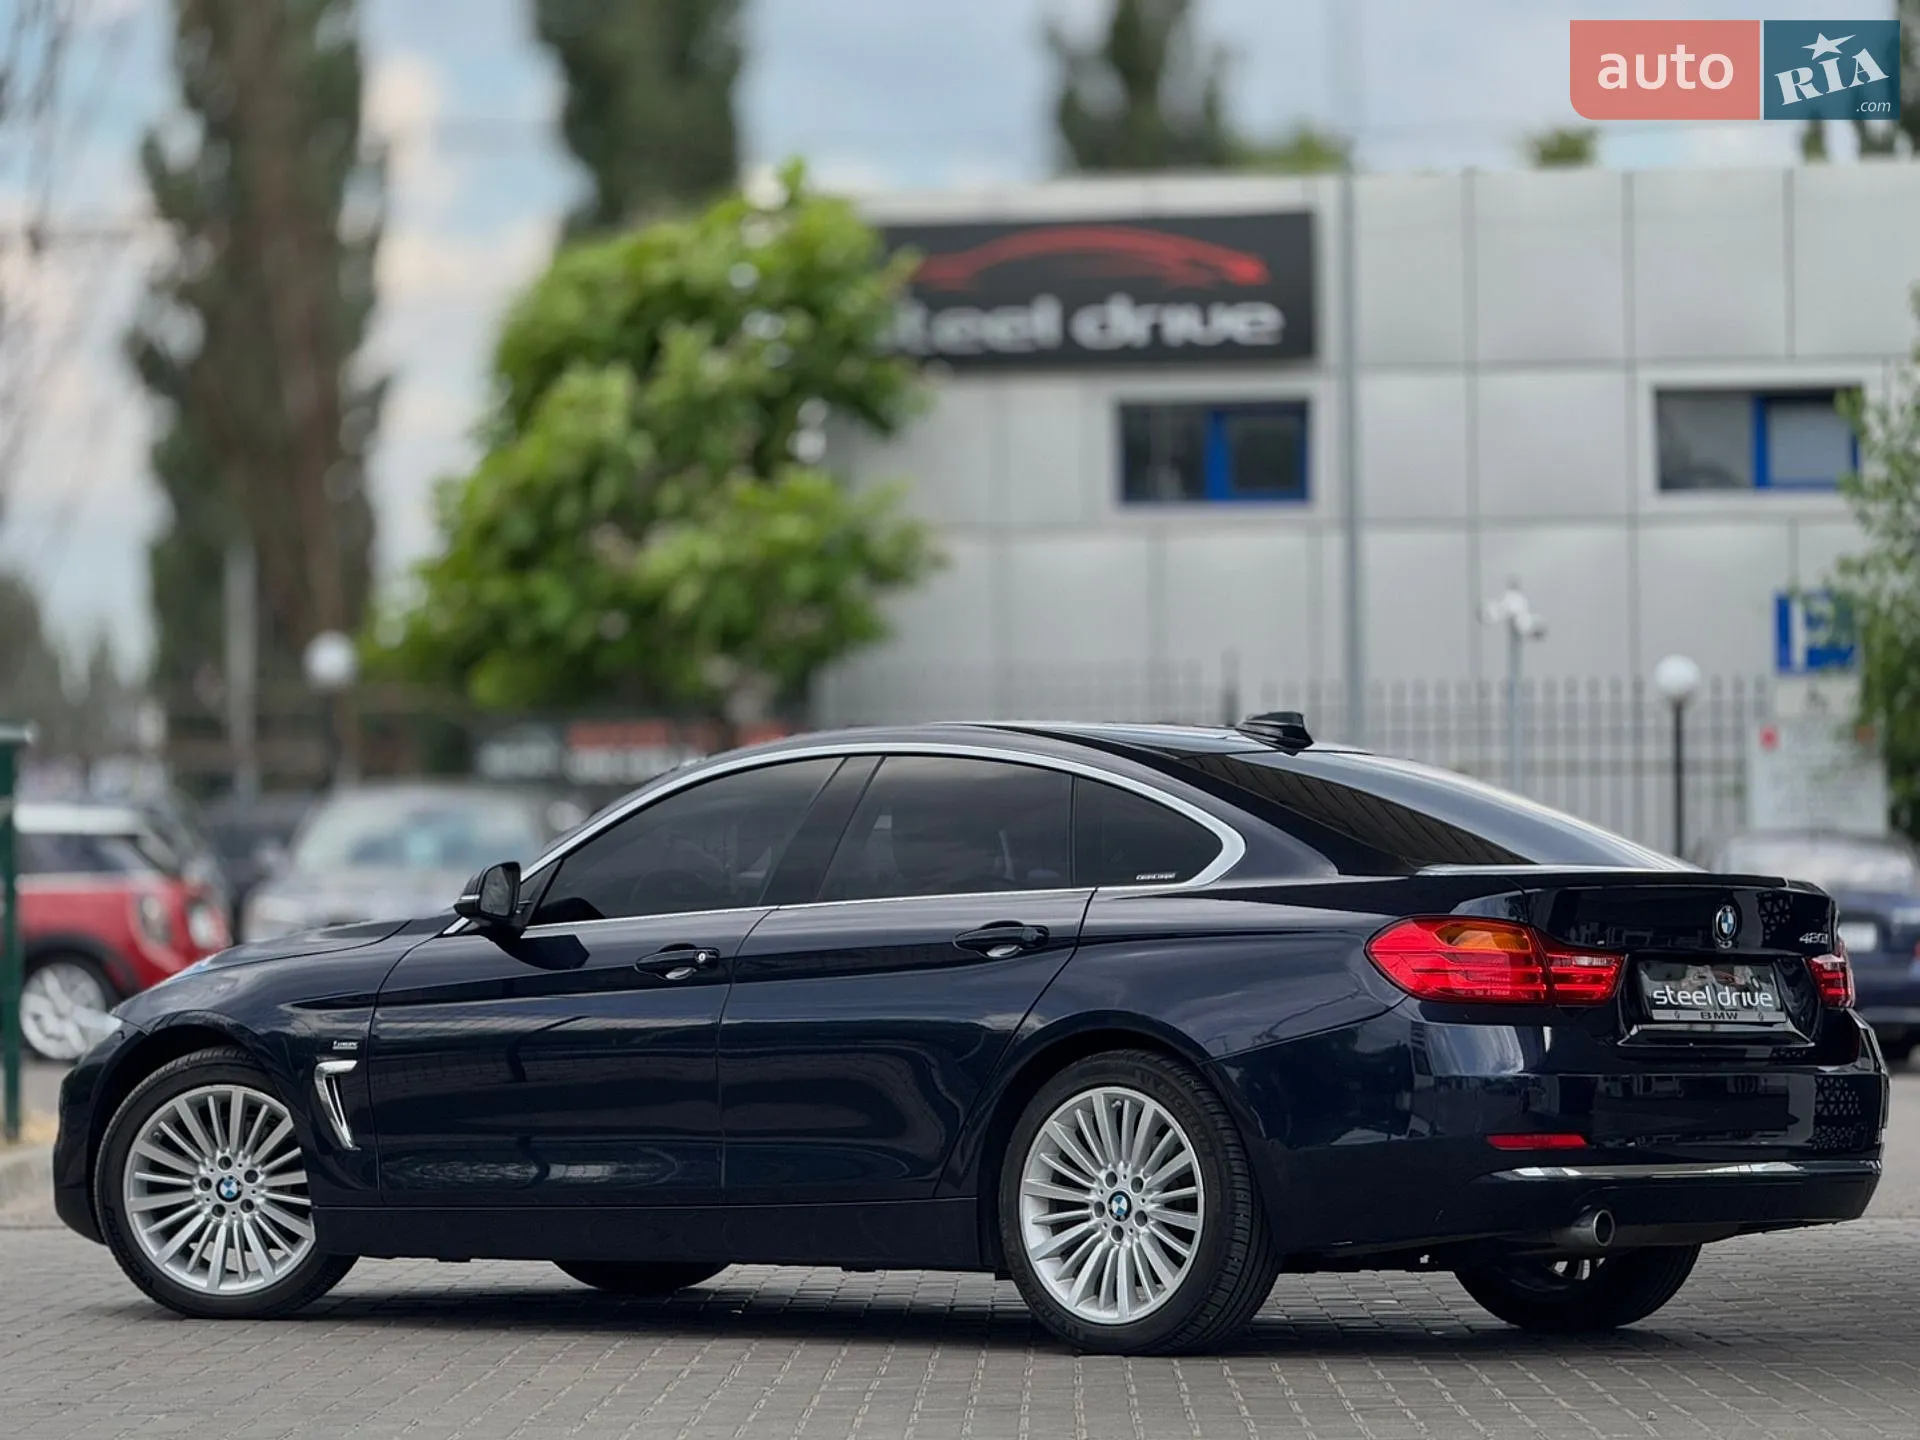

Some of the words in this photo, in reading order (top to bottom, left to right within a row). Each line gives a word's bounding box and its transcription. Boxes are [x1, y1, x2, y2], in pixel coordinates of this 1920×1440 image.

[1069, 292, 1285, 351] drive
[1653, 986, 1712, 1006] steel
[1718, 986, 1773, 1007] drive
[1700, 1011, 1738, 1020] BMW
